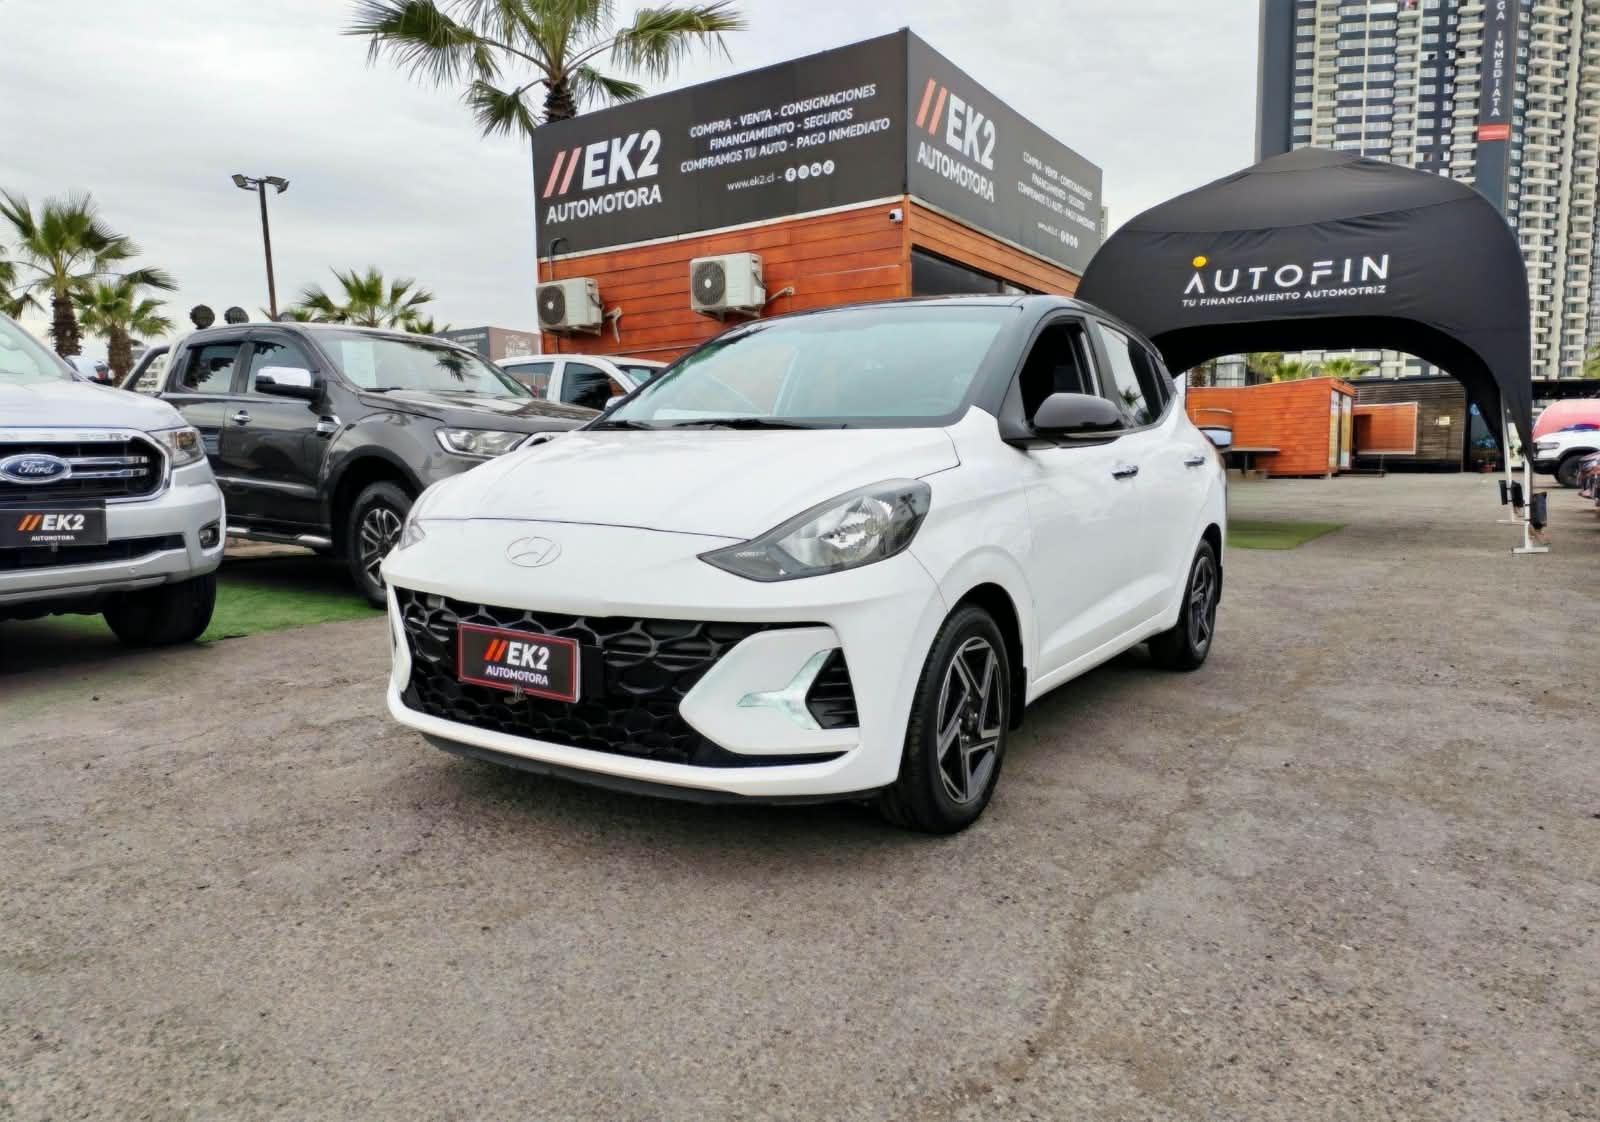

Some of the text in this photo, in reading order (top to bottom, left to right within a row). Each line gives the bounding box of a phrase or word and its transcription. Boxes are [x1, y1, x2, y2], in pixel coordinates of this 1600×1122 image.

[1490, 30, 1504, 117] INMEDIATA
[690, 118, 732, 138] COMPRA
[740, 109, 772, 127] VENTA
[781, 84, 877, 117] CONSIGNACIONES
[709, 121, 795, 151] FINANCIAMIENTO
[804, 108, 854, 130] SEGUROS
[680, 149, 743, 173] COMPRAMOS
[744, 147, 757, 161] TU
[759, 140, 788, 157] AUTO
[796, 131, 826, 149] PAGO
[828, 117, 891, 142] INMEDIATO
[727, 172, 775, 191] www.ek2.cl
[917, 141, 995, 203] AUTOMOTORA
[545, 184, 662, 225] AUTOMOTORA
[1184, 254, 1389, 294] AUTOFIN
[1182, 285, 1387, 307] TU FINANCIAMIENTO AUTOMOTRIZ
[18, 461, 55, 474] Ford
[486, 665, 549, 686] AUTOMOTORA
